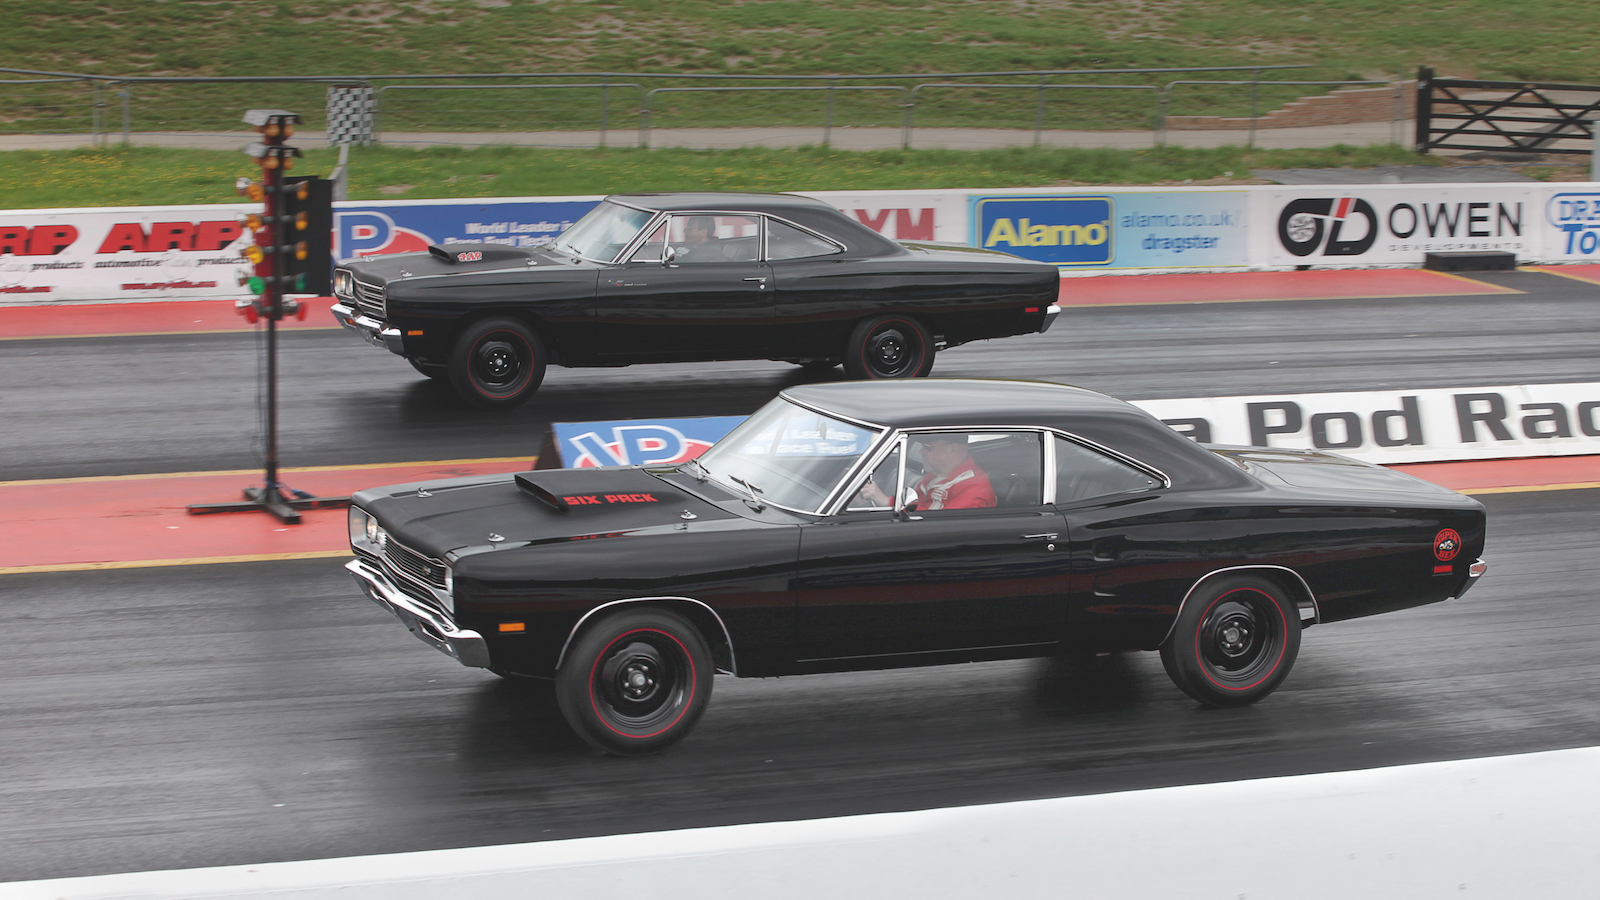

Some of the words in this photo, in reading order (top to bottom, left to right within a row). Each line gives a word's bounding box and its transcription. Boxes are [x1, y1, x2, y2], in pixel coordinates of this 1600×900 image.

[465, 222, 508, 235] World
[508, 220, 561, 234] Leader
[1121, 210, 1242, 228] alamo.co.uk/
[1388, 202, 1522, 239] OWEN
[95, 221, 243, 255] ARP
[330, 211, 396, 260] P
[984, 218, 1109, 248] Alamo
[1141, 233, 1220, 254] dragster
[1388, 242, 1524, 251] DEVELOPMENTS
[30, 260, 84, 272] products
[1245, 396, 1425, 449] Pod
[562, 495, 602, 505] SIX
[604, 493, 659, 504] PACK
[1436, 531, 1458, 546] SUPER
[1438, 548, 1456, 559] BEE
